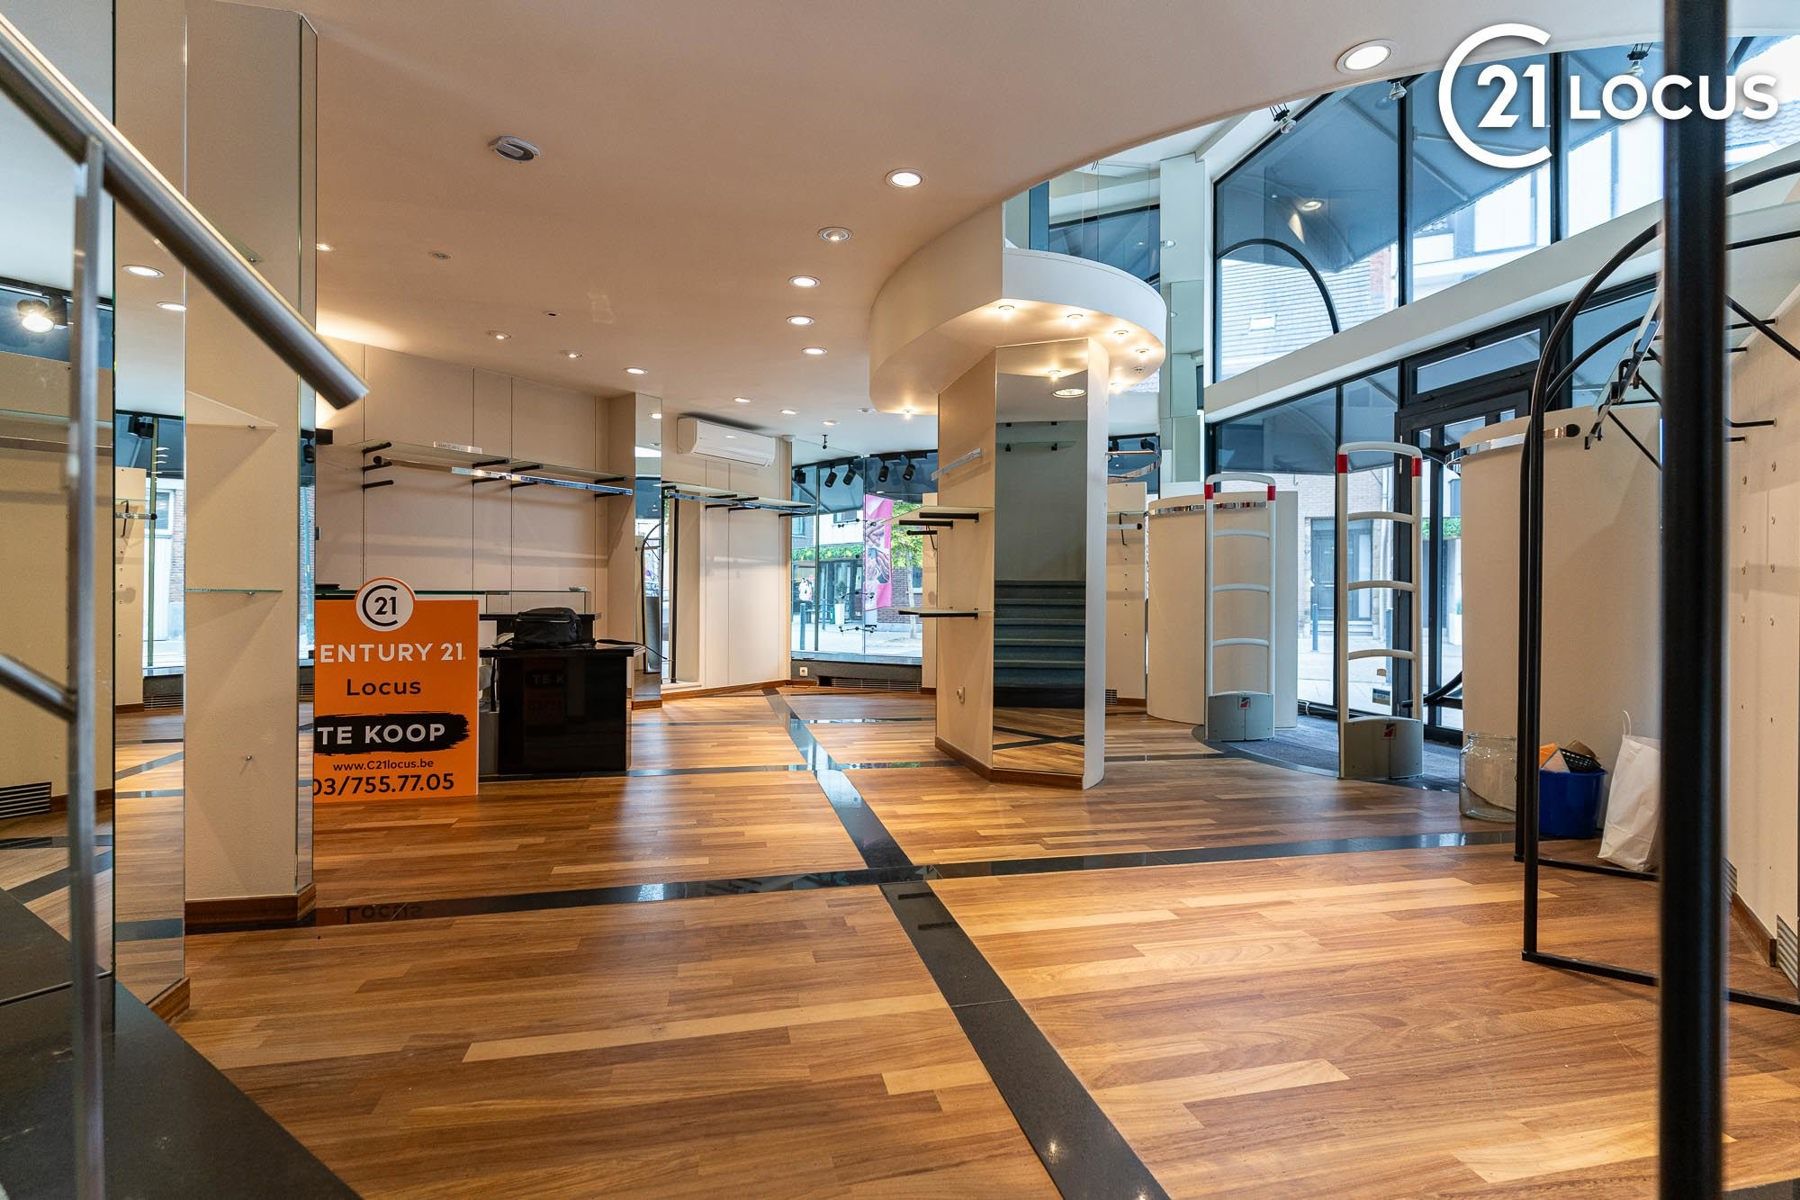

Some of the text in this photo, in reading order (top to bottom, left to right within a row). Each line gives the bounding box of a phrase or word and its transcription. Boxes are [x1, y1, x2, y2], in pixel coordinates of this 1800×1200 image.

[315, 642, 433, 663] ENTURY
[346, 678, 422, 696] Locus
[317, 723, 446, 745] TE KOOP
